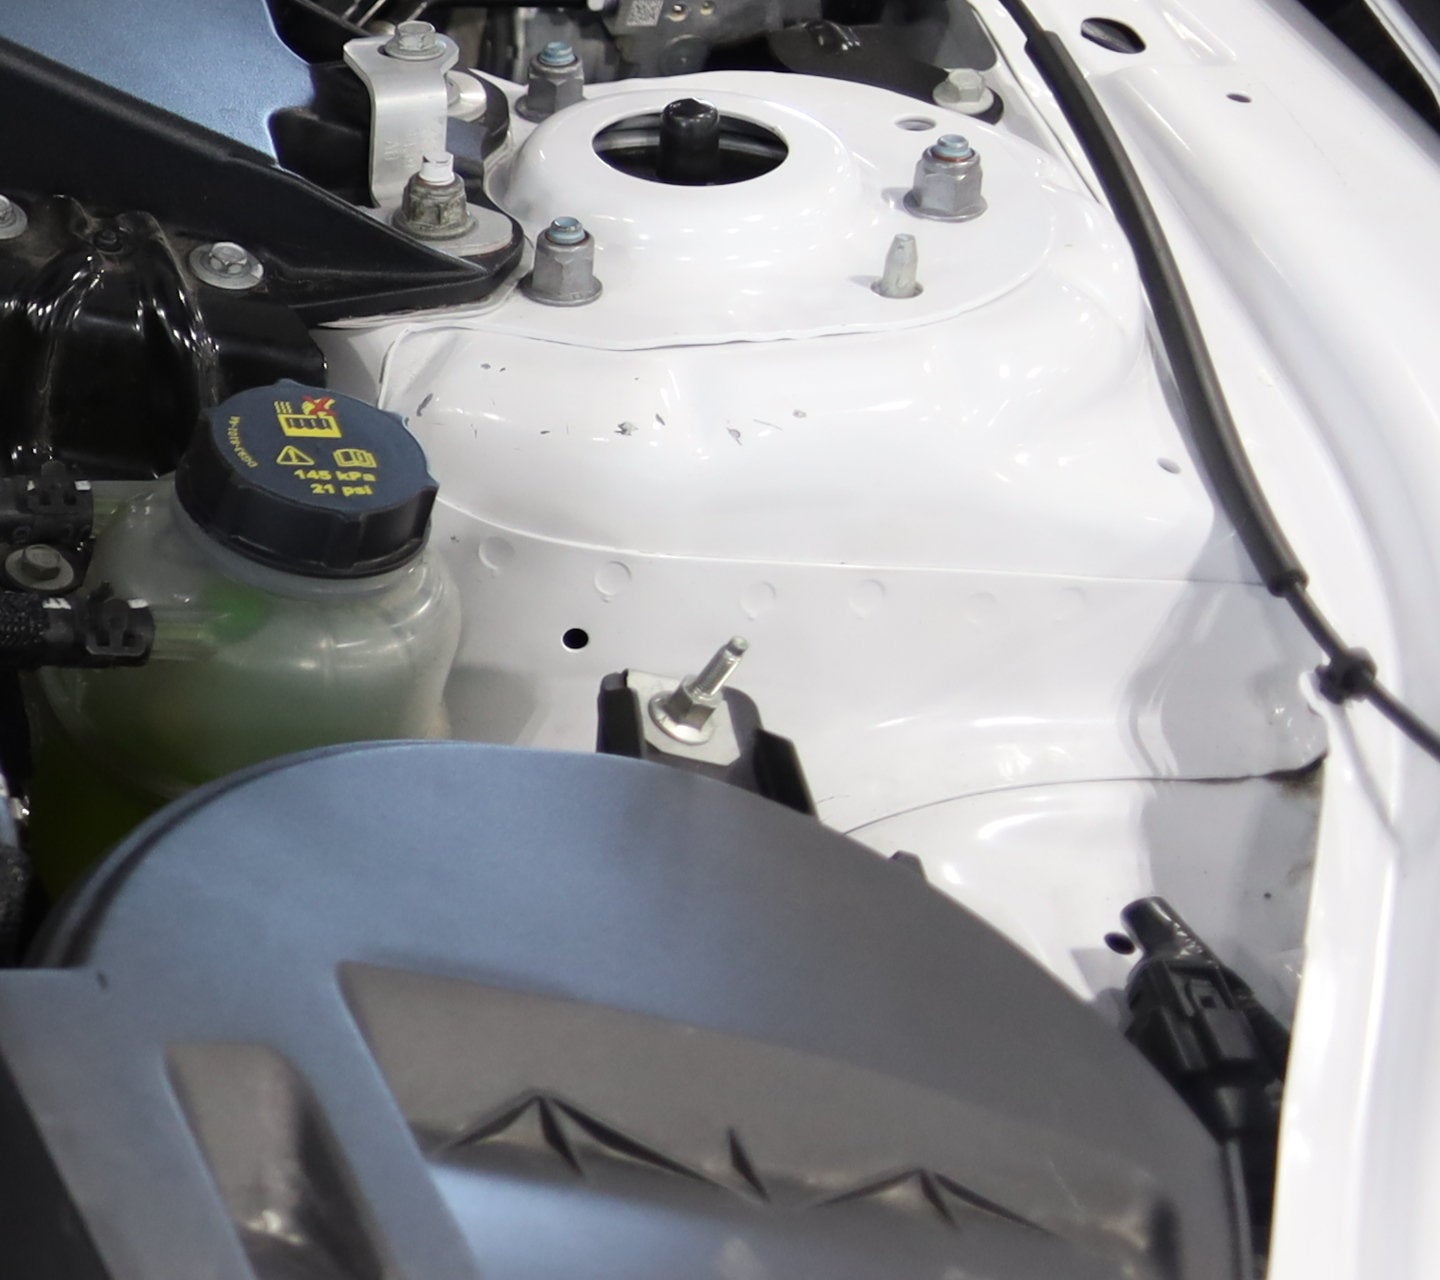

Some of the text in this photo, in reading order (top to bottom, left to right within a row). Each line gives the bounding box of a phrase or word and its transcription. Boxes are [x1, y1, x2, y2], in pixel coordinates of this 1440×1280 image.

[294, 468, 377, 482] 145 kPa
[309, 483, 374, 497] 21 psi
